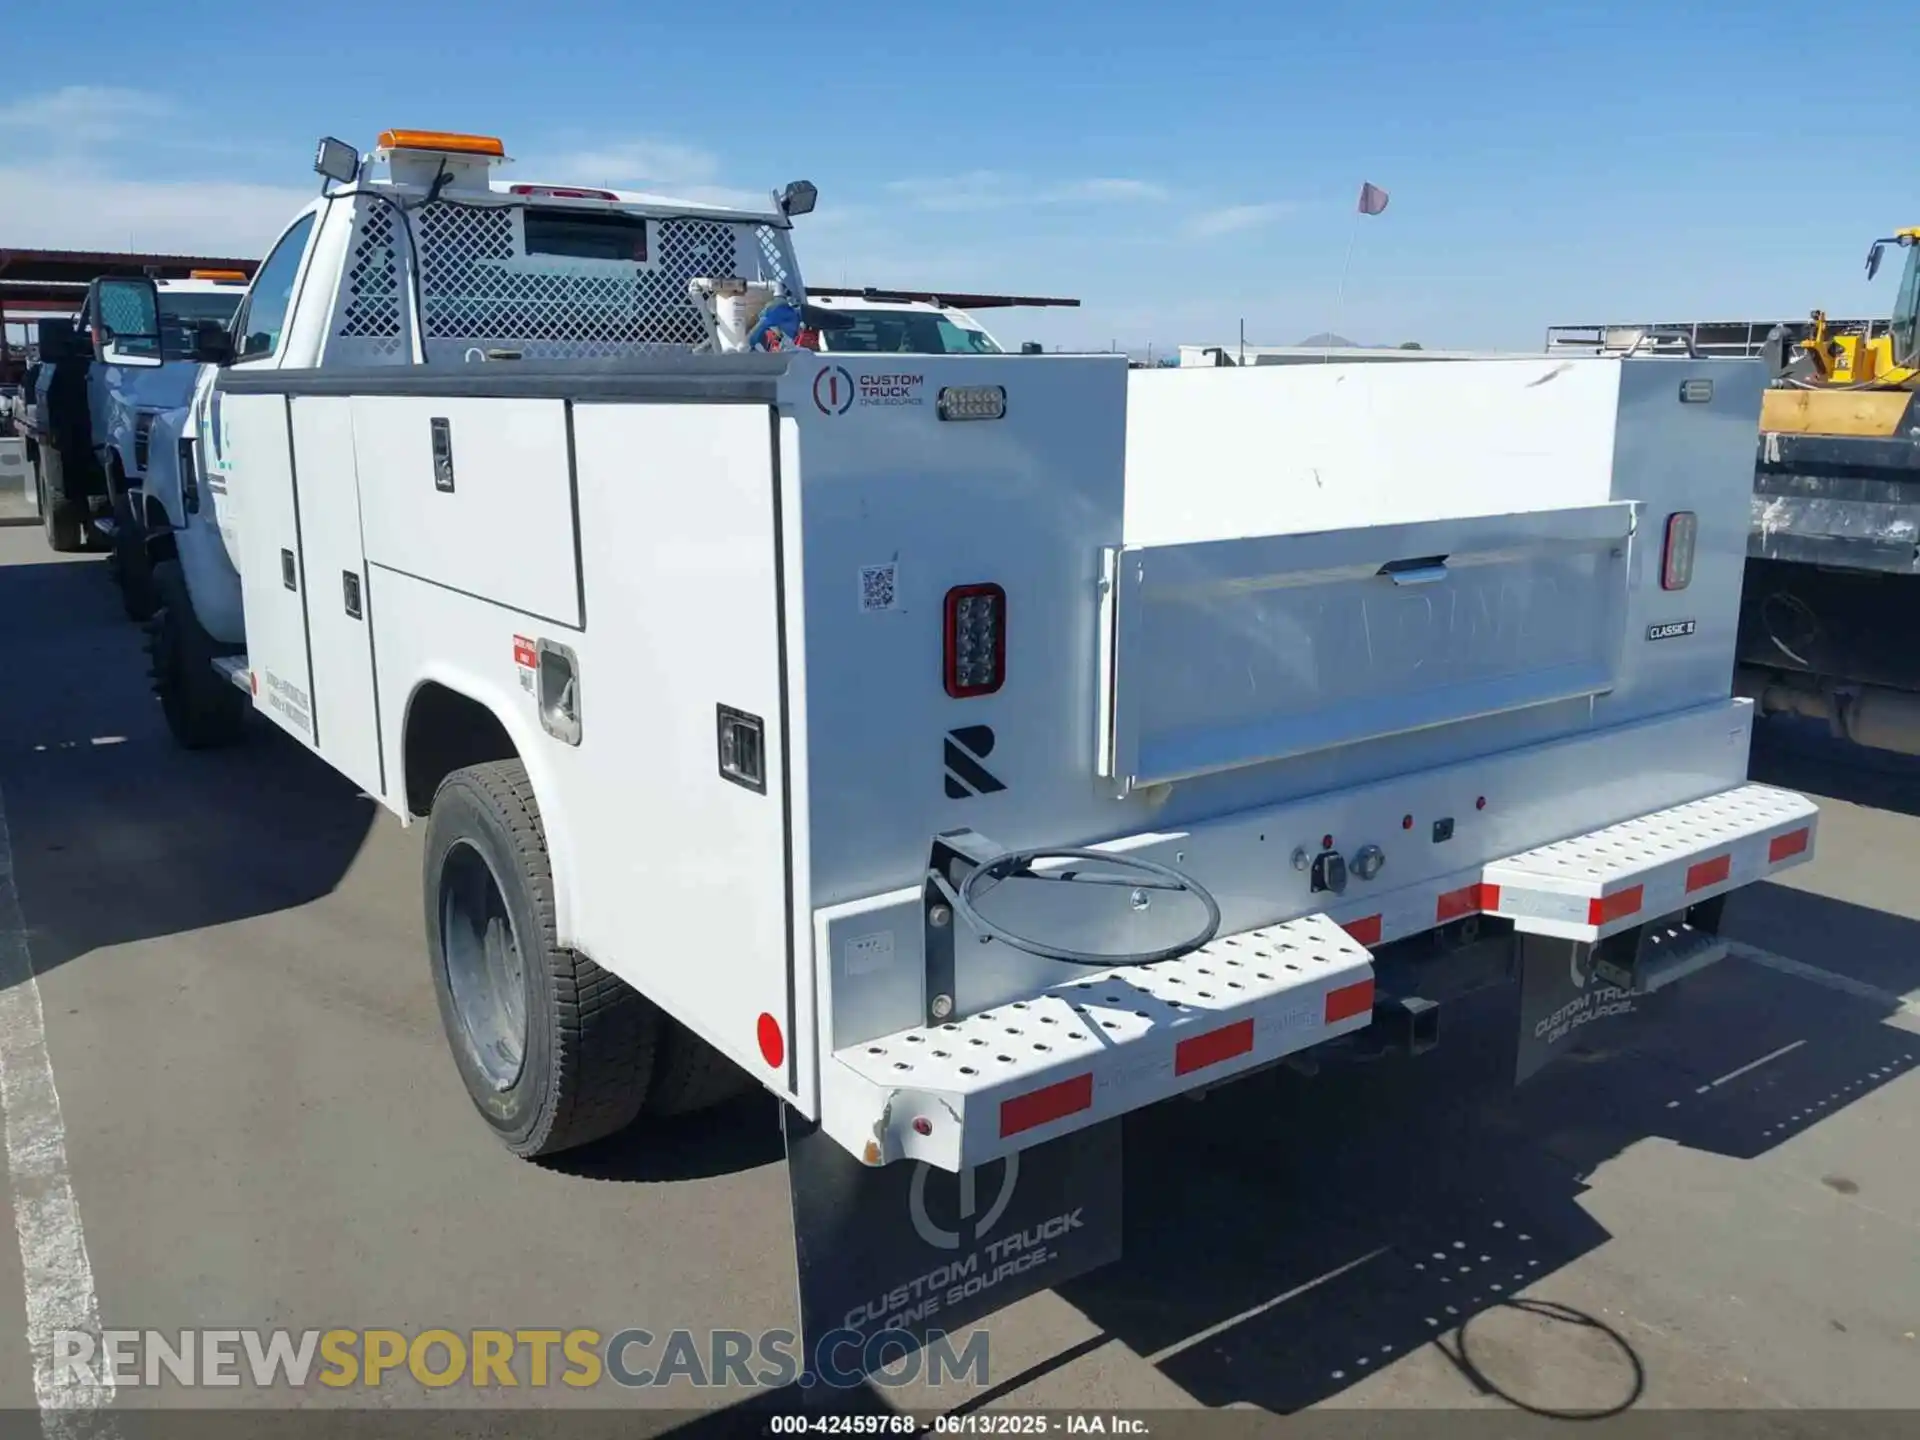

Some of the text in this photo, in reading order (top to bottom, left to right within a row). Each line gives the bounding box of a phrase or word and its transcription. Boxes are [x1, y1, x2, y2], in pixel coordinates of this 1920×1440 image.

[860, 375, 924, 386] CUSTOM
[860, 386, 911, 397] TRUCK
[1650, 623, 1686, 638] CLASSIC
[1535, 993, 1590, 1038] CUSTOM
[844, 1207, 1085, 1331] CUSTOM TRUCK
[884, 1297, 940, 1332] ONE
